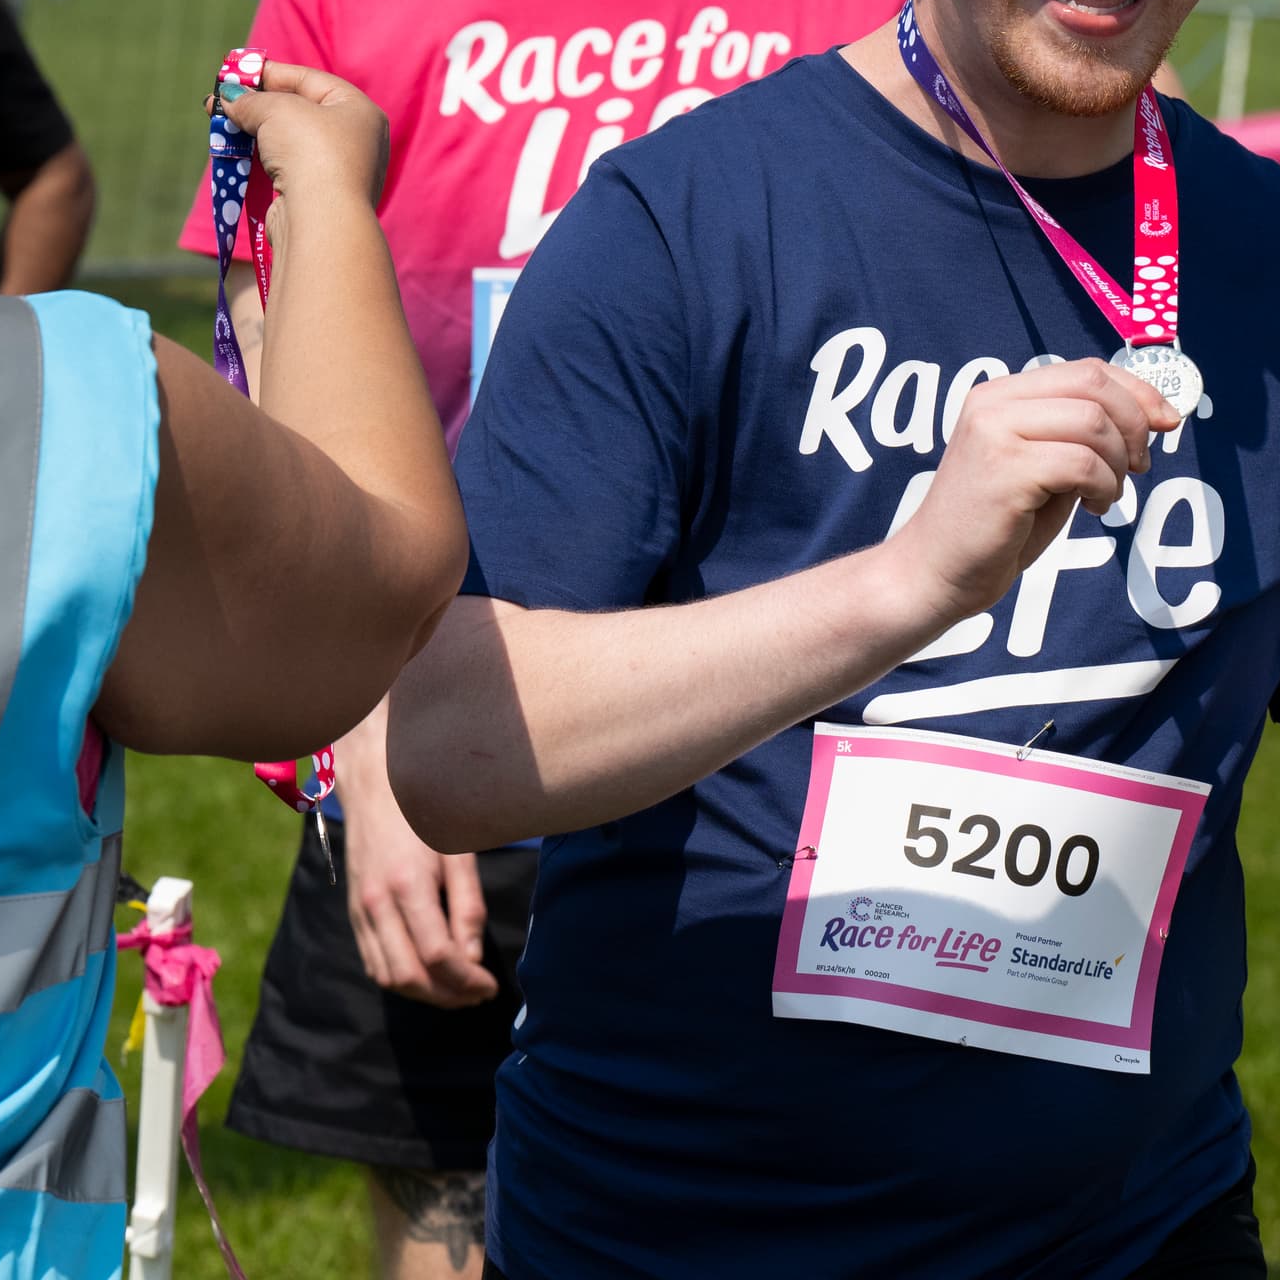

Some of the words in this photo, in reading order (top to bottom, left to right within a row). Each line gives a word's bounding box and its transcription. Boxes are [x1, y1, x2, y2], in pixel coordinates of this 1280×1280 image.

[439, 19, 666, 123] Race
[676, 6, 791, 84] for
[1143, 139, 1169, 171] Race
[255, 222, 265, 250] Life
[1079, 262, 1120, 299] Standard
[1110, 299, 1130, 317] Life
[227, 342, 240, 375] CANCER
[836, 740, 852, 753] 5k
[902, 802, 1101, 897] 5200
[874, 908, 910, 919] RESEARCH
[875, 902, 903, 911] CANCER
[819, 917, 894, 952] Race
[896, 924, 937, 952] for
[933, 927, 1002, 963] Life
[1015, 932, 1037, 943] Proud
[1037, 936, 1063, 948] Partner
[864, 970, 890, 980] 000201
[1007, 969, 1019, 977] Part
[1027, 973, 1050, 984] Phoenix
[1051, 978, 1068, 987] Group
[1010, 947, 1085, 975] Standard
[1084, 960, 1113, 980] Life
